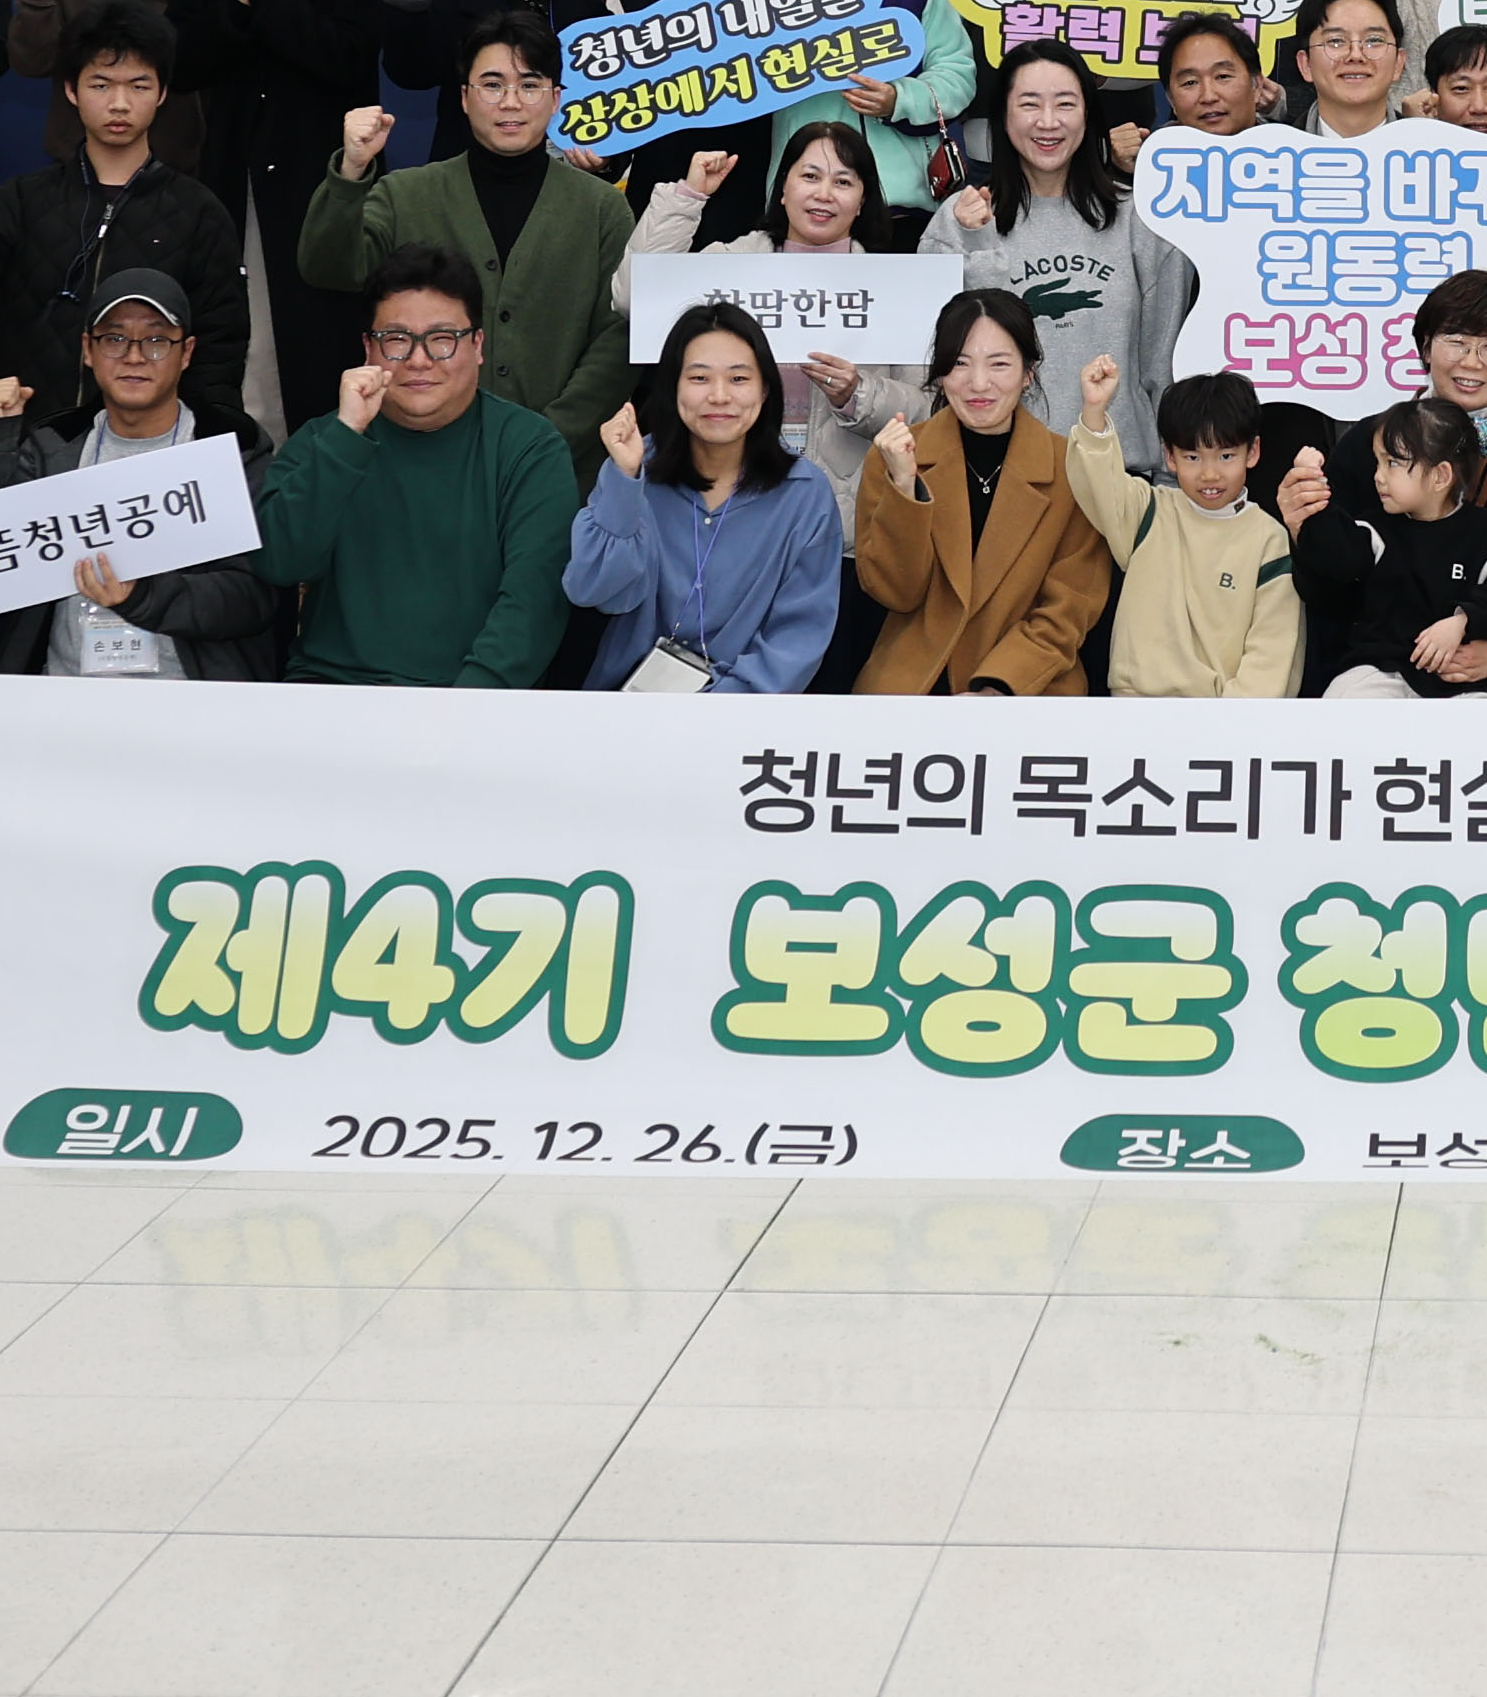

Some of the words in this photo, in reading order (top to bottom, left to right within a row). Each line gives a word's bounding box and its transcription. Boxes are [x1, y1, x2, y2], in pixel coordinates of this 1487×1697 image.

[562, 56, 755, 143] 상상에서
[760, 21, 909, 91] 현실로
[571, 8, 714, 79] 청년의
[1151, 145, 1370, 224] 지역을
[1009, 254, 1115, 286] LACOSTE
[1258, 229, 1473, 307] 원동력
[1223, 312, 1369, 391] 보성
[738, 747, 988, 837] 청년의
[1011, 755, 1353, 842] 목소리가
[139, 860, 635, 1060] 제4기
[711, 879, 1249, 1079] 보성군
[56, 1103, 199, 1158] 일시
[311, 1114, 505, 1161] 2025.
[532, 1120, 613, 1163] 12.
[633, 1121, 859, 1168] 26.(금)
[1116, 1128, 1253, 1171] 장소
